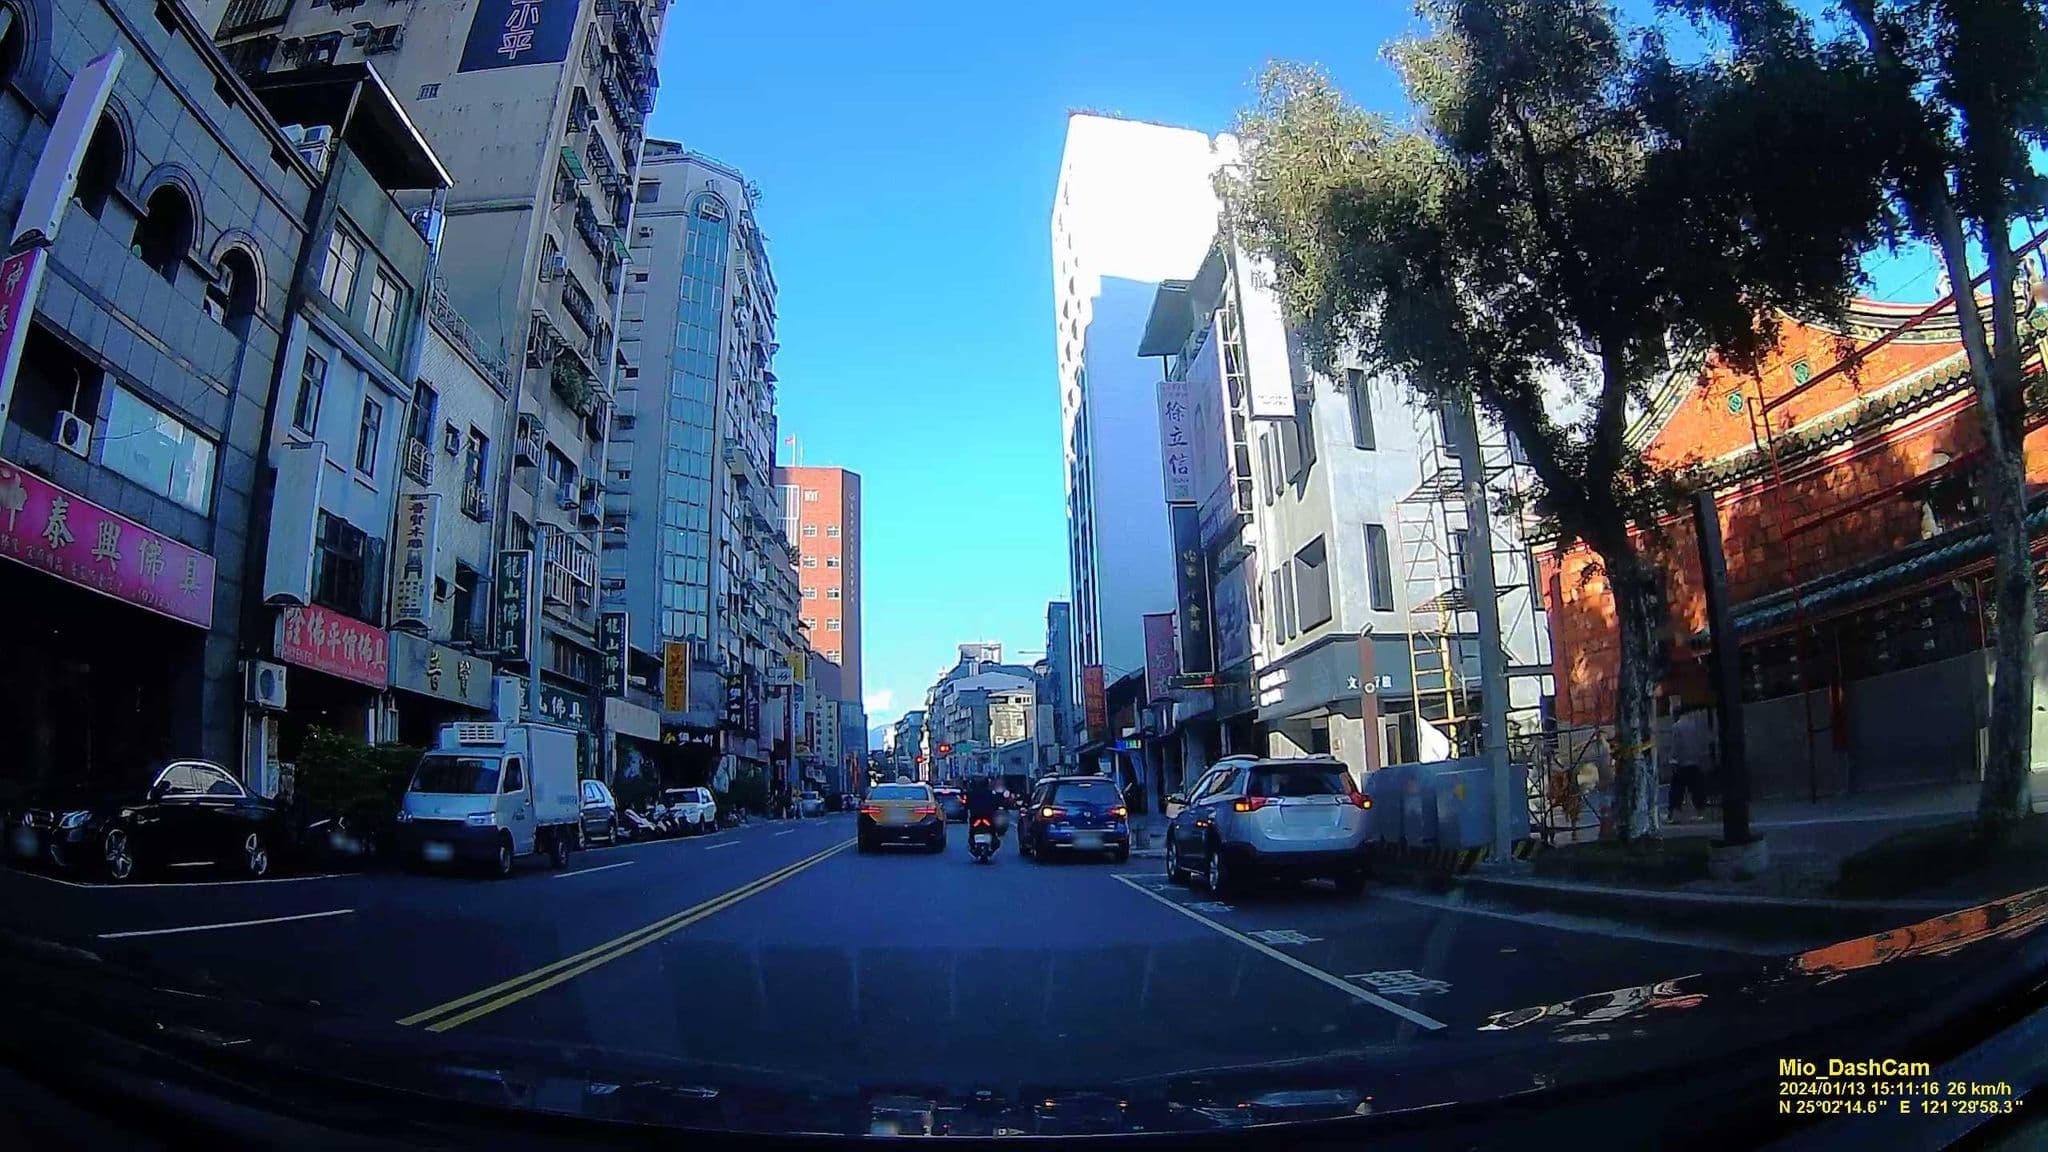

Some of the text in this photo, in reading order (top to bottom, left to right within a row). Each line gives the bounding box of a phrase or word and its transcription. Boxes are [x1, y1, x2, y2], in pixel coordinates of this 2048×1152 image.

[1165, 400, 1189, 475] 徐立信
[503, 555, 522, 655] 龍山佛具
[605, 617, 621, 690] 龍山佛具
